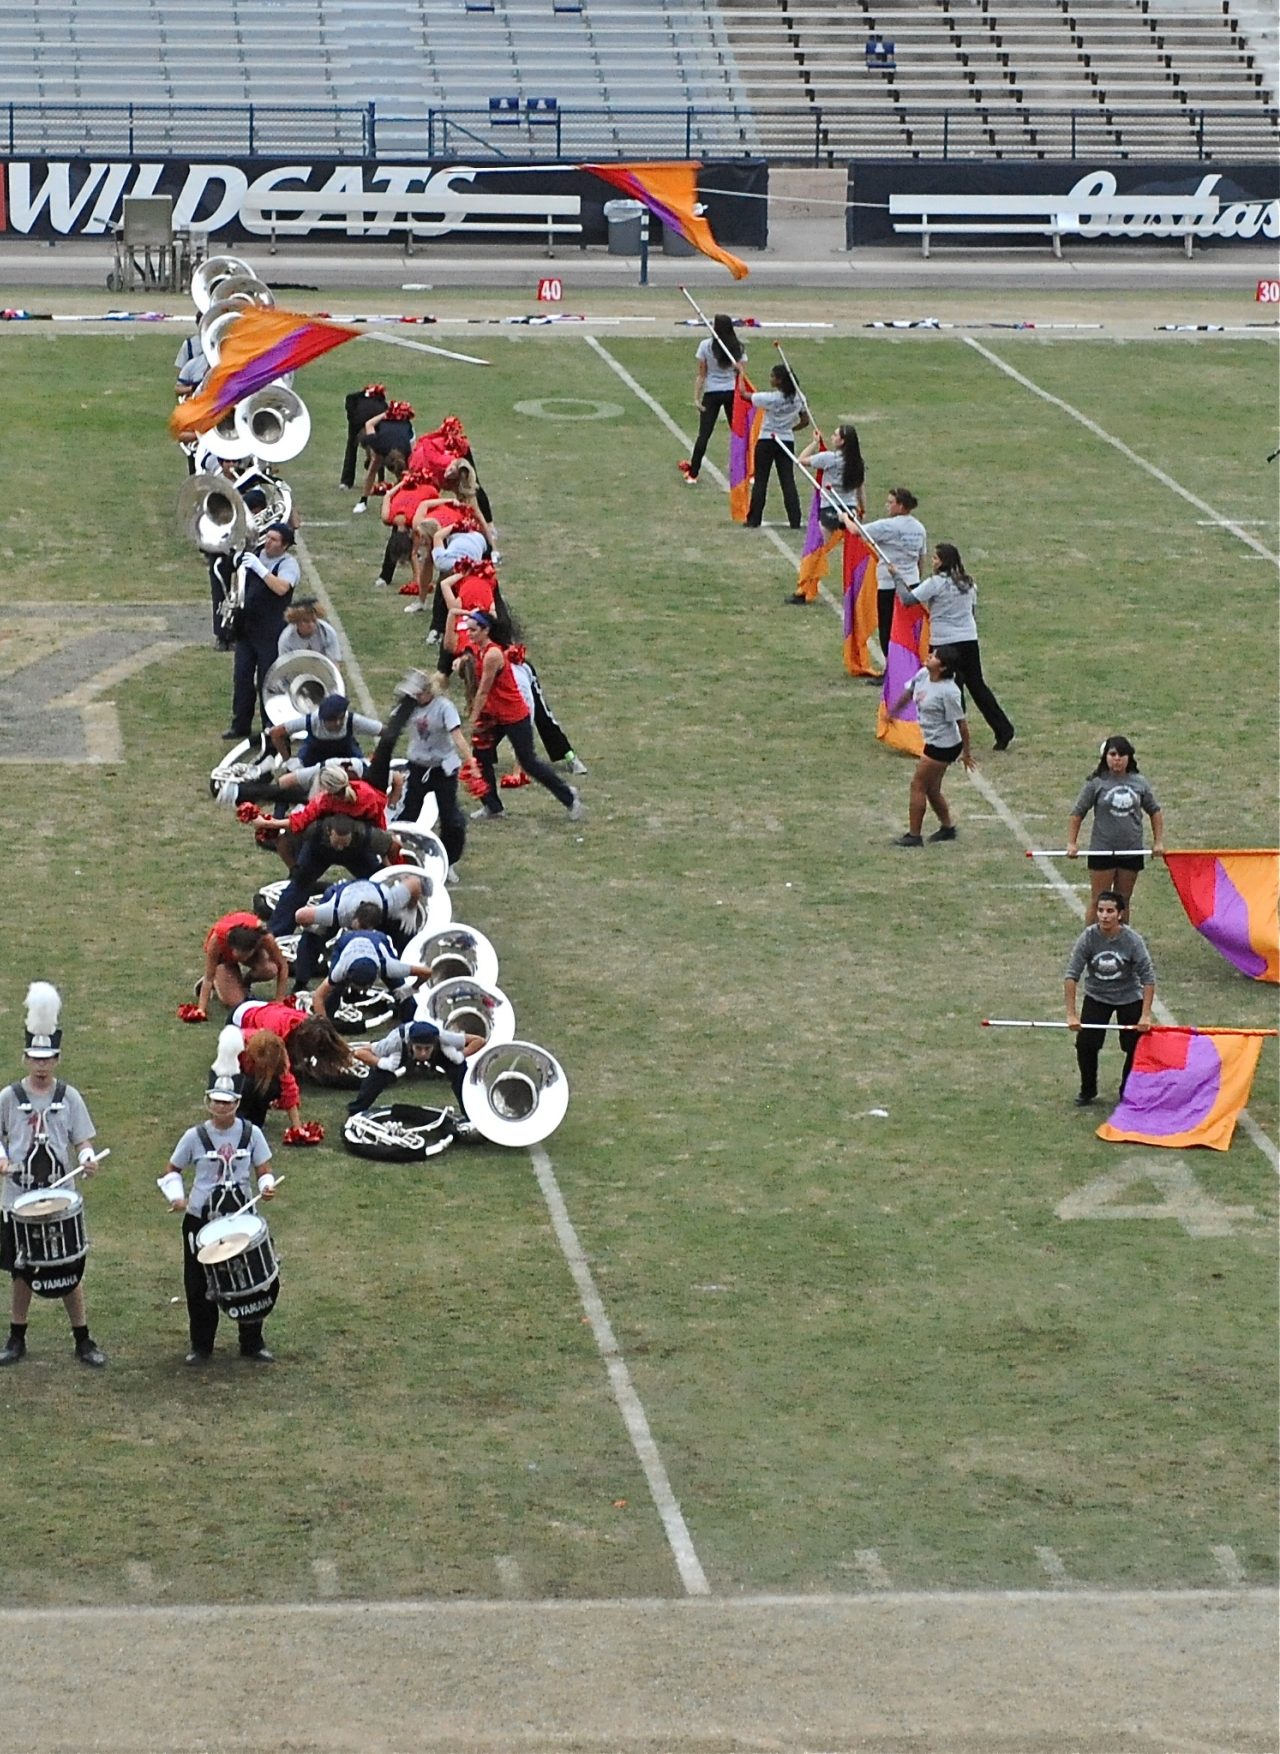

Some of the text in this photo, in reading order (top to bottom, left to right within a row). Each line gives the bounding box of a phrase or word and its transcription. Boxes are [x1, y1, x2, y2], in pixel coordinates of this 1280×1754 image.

[541, 280, 561, 300] 40
[1260, 281, 1280, 302] 30
[42, 1274, 78, 1291] YAMAHA
[238, 1296, 273, 1316] YAMAHA
